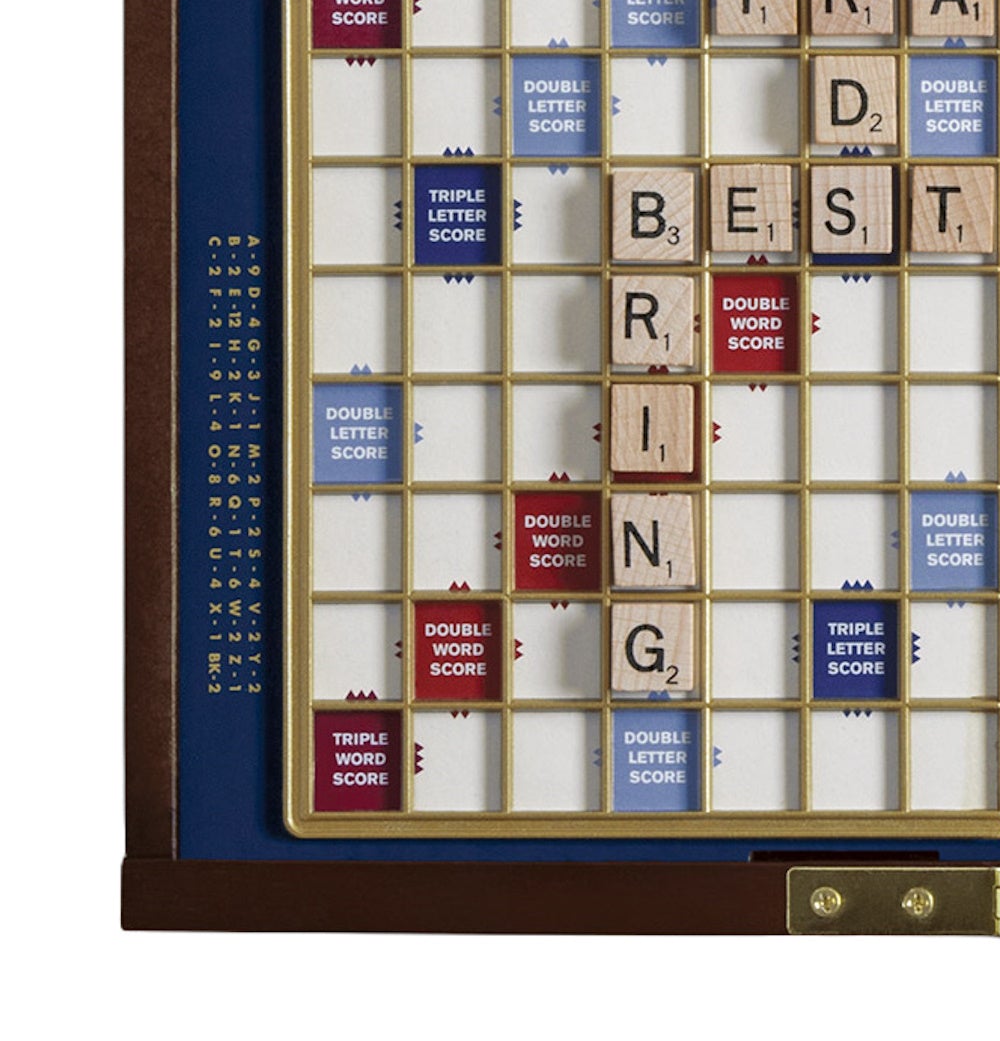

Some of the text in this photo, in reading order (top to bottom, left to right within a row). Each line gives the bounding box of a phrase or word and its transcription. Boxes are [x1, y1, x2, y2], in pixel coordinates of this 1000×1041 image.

[428, 188, 486, 204] TRIPLE
[427, 208, 488, 223] LETTER
[428, 227, 487, 243] SCORE
[721, 296, 791, 312] DOUBLE
[729, 315, 783, 332] WORD
[727, 335, 785, 351] SCORE
[523, 514, 592, 529] DOUBLE
[531, 533, 584, 549] WORD
[528, 553, 587, 568] SCORE
[826, 621, 885, 637] TRIPLE
[826, 641, 887, 657] LETTER
[827, 660, 885, 676] SCORE
